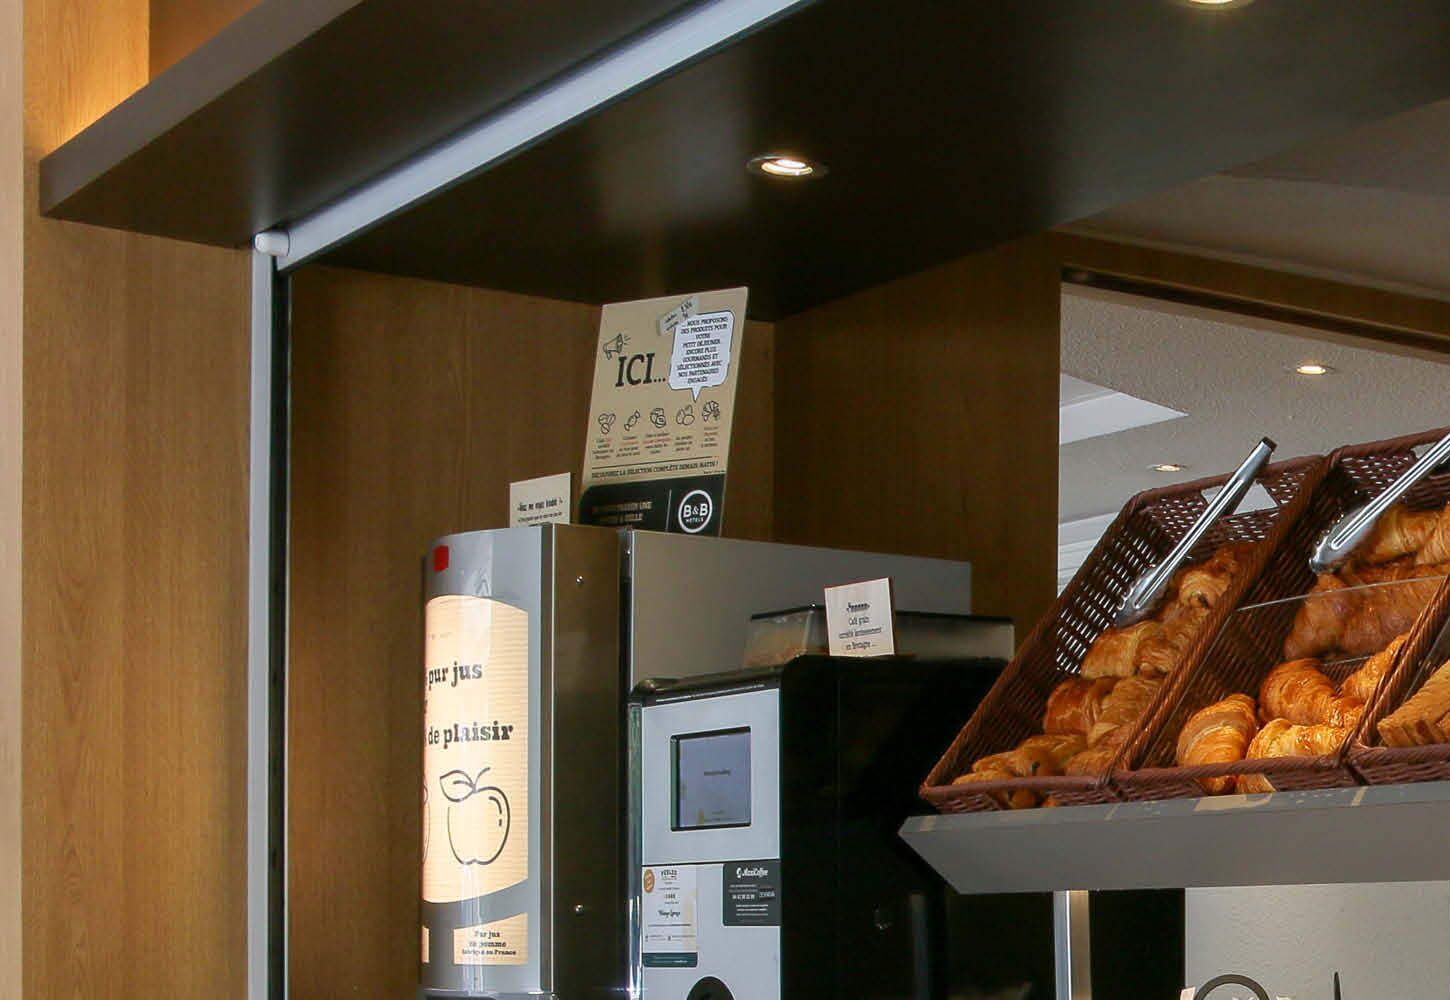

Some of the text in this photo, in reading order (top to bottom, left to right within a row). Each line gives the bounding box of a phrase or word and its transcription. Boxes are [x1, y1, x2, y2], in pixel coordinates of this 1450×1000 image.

[683, 503, 709, 518] B&B
[428, 661, 483, 690] pur jus
[427, 720, 514, 749] de plaisir
